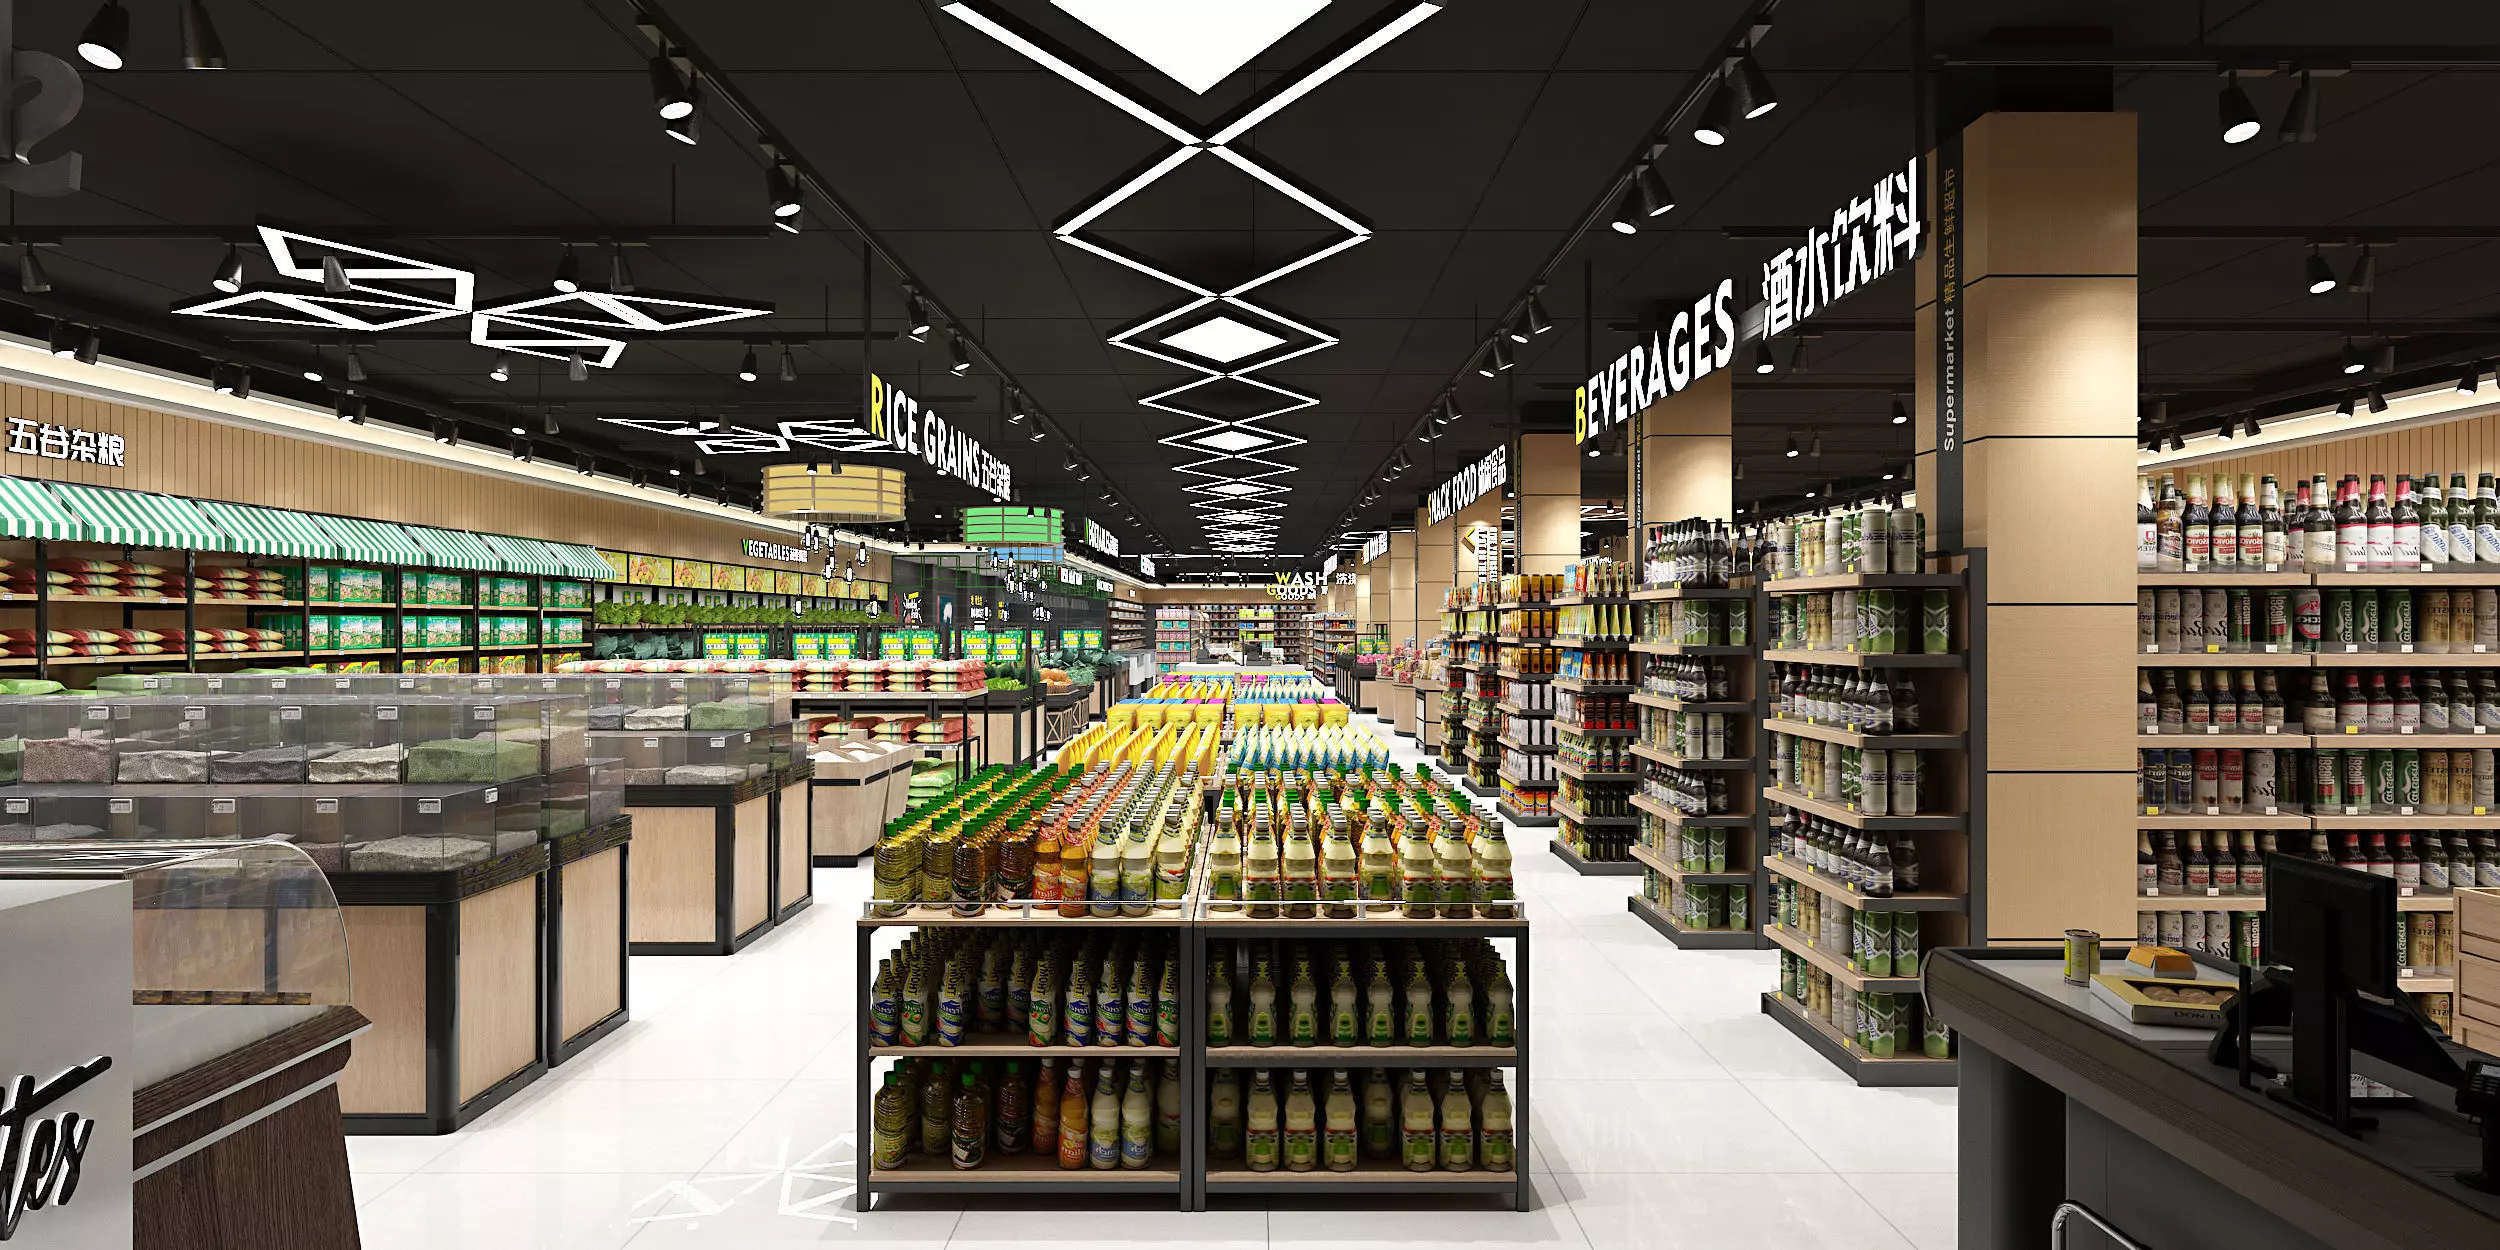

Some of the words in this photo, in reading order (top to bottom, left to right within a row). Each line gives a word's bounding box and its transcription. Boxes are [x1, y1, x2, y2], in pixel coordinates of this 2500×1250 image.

[1575, 278, 1736, 446] BEVERAGES
[1762, 157, 1921, 341] 酒水饮料
[1944, 307, 1956, 452] Supermarket
[5, 415, 125, 468] 五谷杂粮
[871, 373, 918, 455] RICE
[923, 409, 980, 488] GRAINS
[1427, 480, 1450, 527] SNACK
[1452, 464, 1476, 513] FOOD
[742, 539, 789, 562] VEGETABLES
[1275, 571, 1328, 587] WASH
[1266, 584, 1316, 596] GOODS
